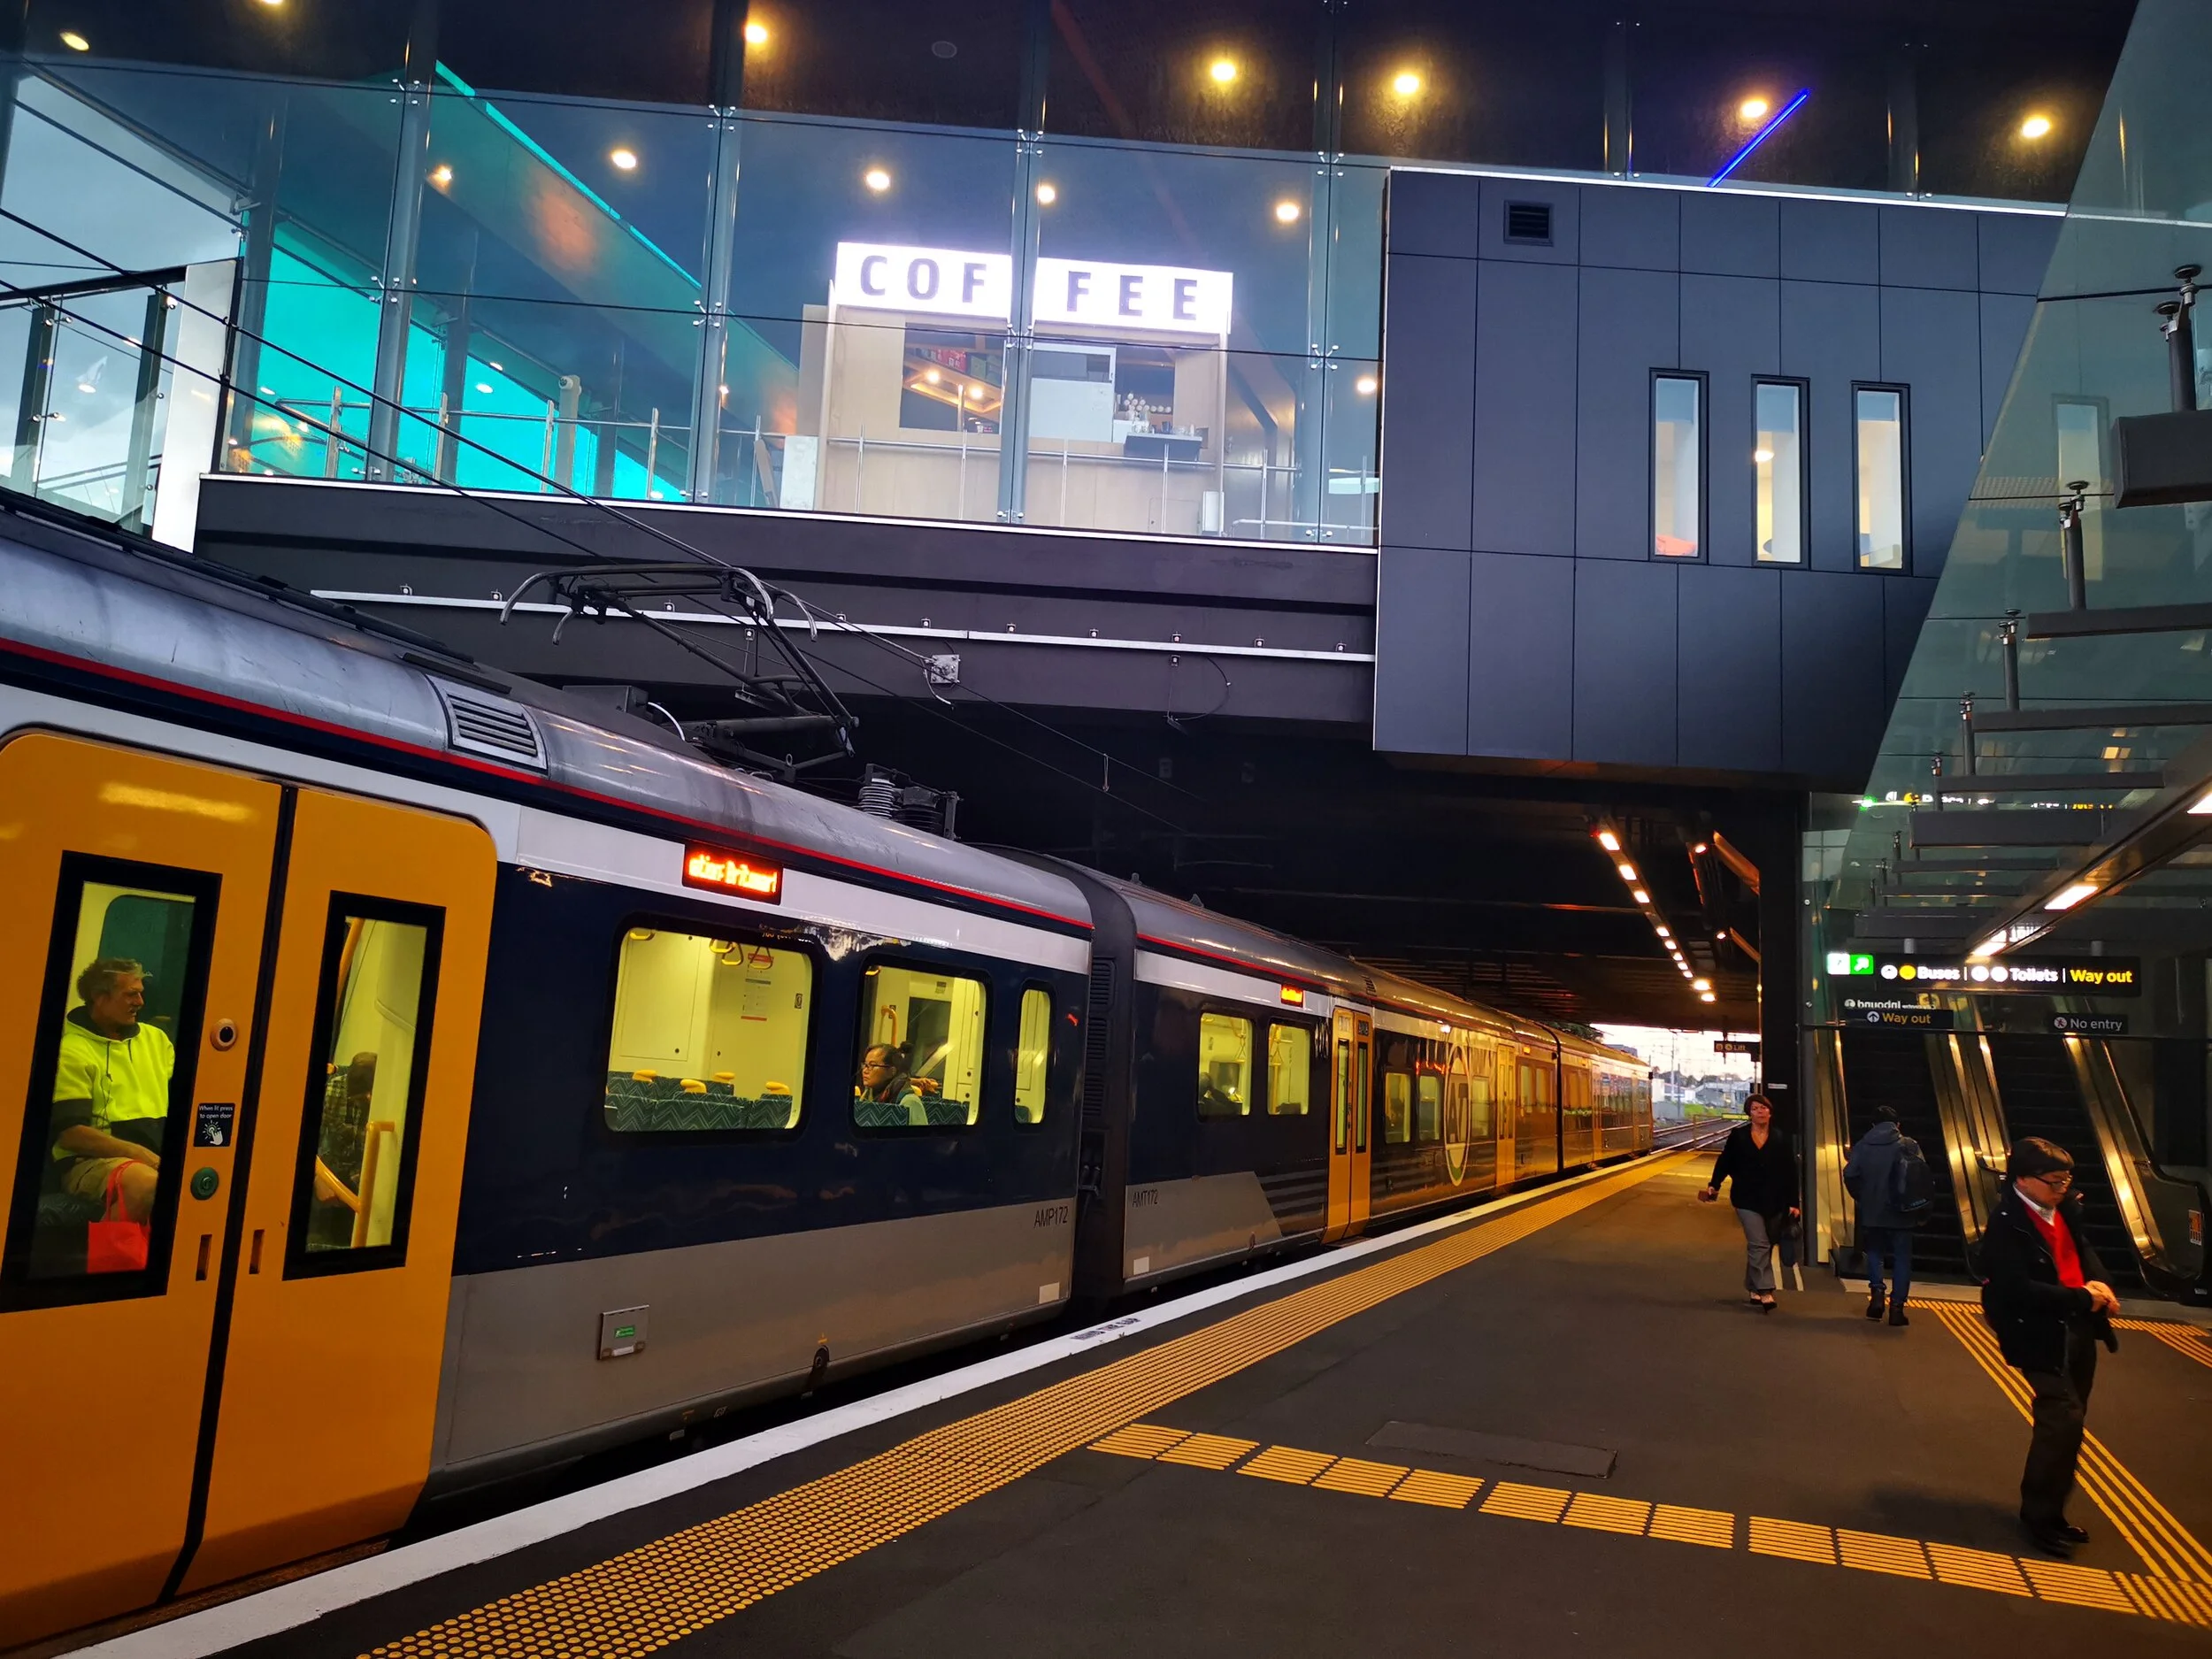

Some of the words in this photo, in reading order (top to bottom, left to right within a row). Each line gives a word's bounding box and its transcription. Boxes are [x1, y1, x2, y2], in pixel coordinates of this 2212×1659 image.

[1916, 965, 1961, 979] Buses
[2009, 967, 2058, 982] Toilets
[2070, 969, 2104, 985] Way
[2106, 971, 2132, 983] out
[1882, 1012, 1909, 1025] Way
[1910, 1013, 1932, 1025] out
[2070, 1018, 2087, 1029] No
[2090, 1020, 2123, 1032] entry
[1132, 1189, 1158, 1208] AMT172
[1033, 1206, 1069, 1229] AMP172
